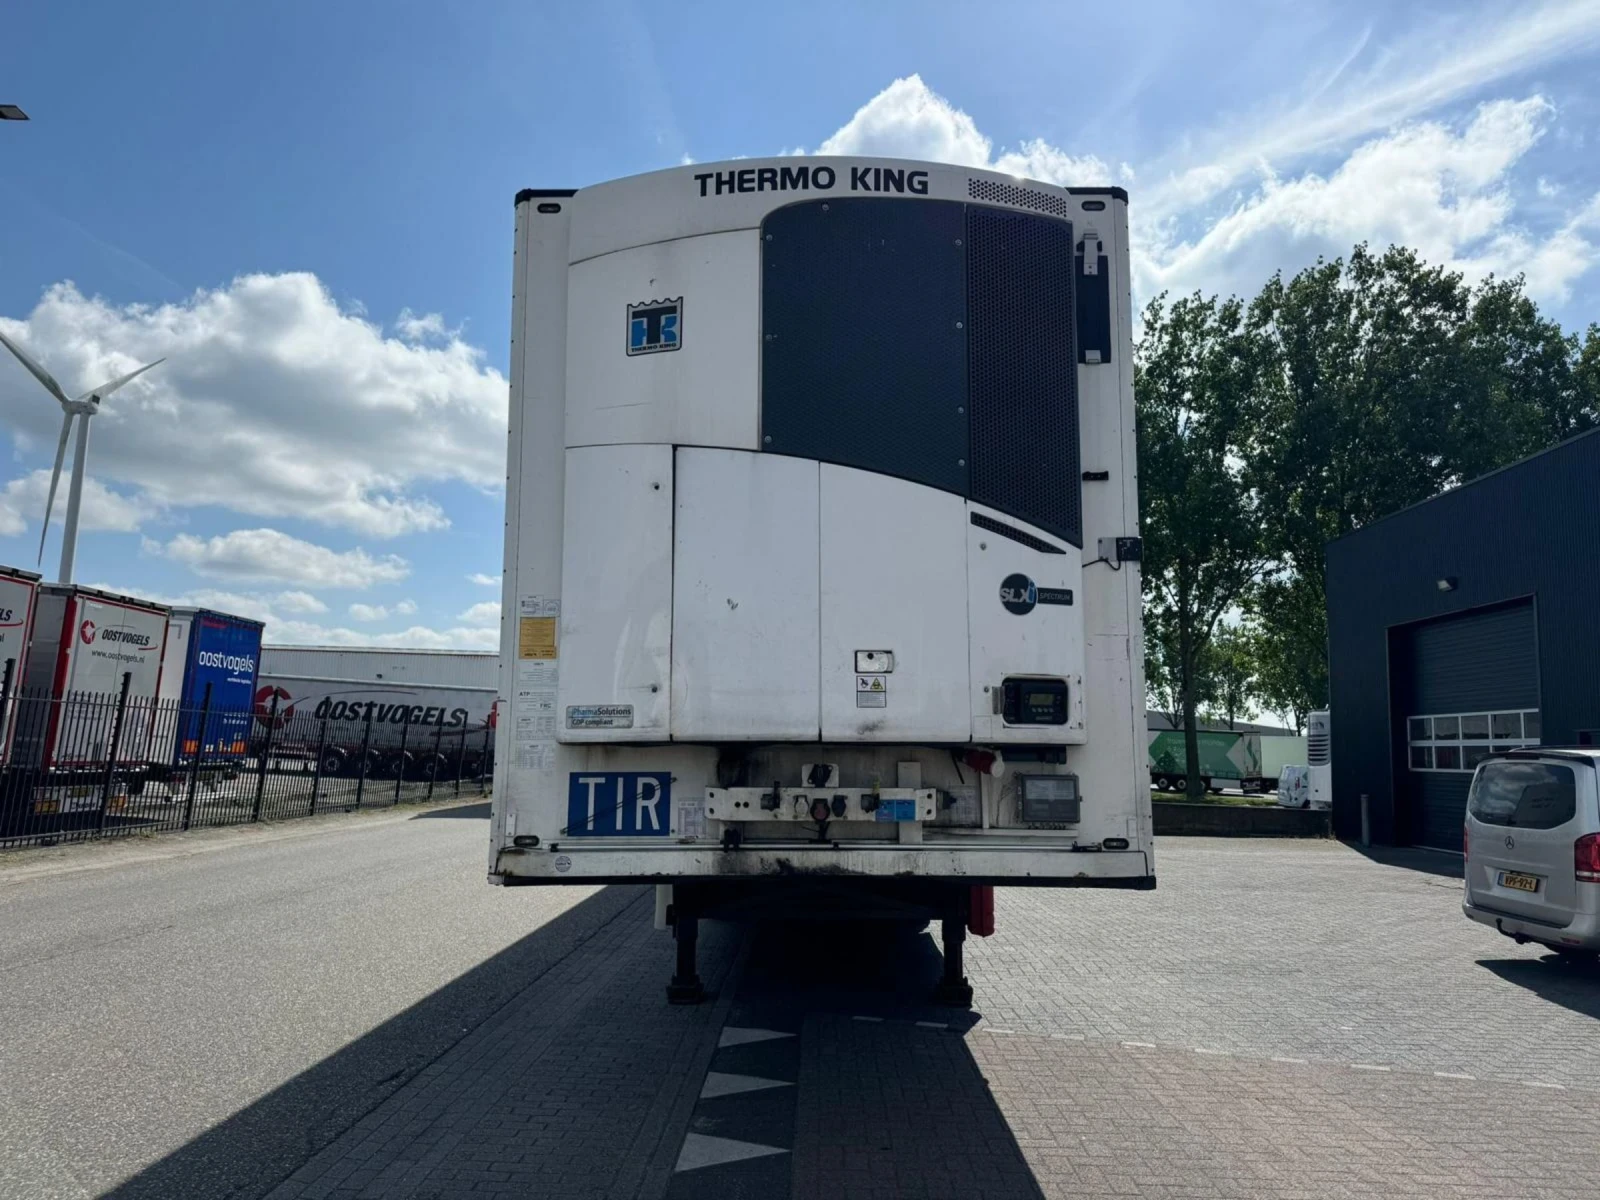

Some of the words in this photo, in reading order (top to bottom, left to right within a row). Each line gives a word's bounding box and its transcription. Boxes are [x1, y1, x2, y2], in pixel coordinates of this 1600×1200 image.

[694, 166, 836, 197] THERMO
[851, 167, 929, 195] KING
[1039, 592, 1071, 600] SPECTRUM
[101, 628, 151, 647] OOSTVOGELS
[91, 650, 146, 664] www.oostvogels.nl
[198, 650, 254, 675] oostvogels
[315, 699, 466, 728] OOSTVOGELS
[578, 777, 661, 831] TIR
